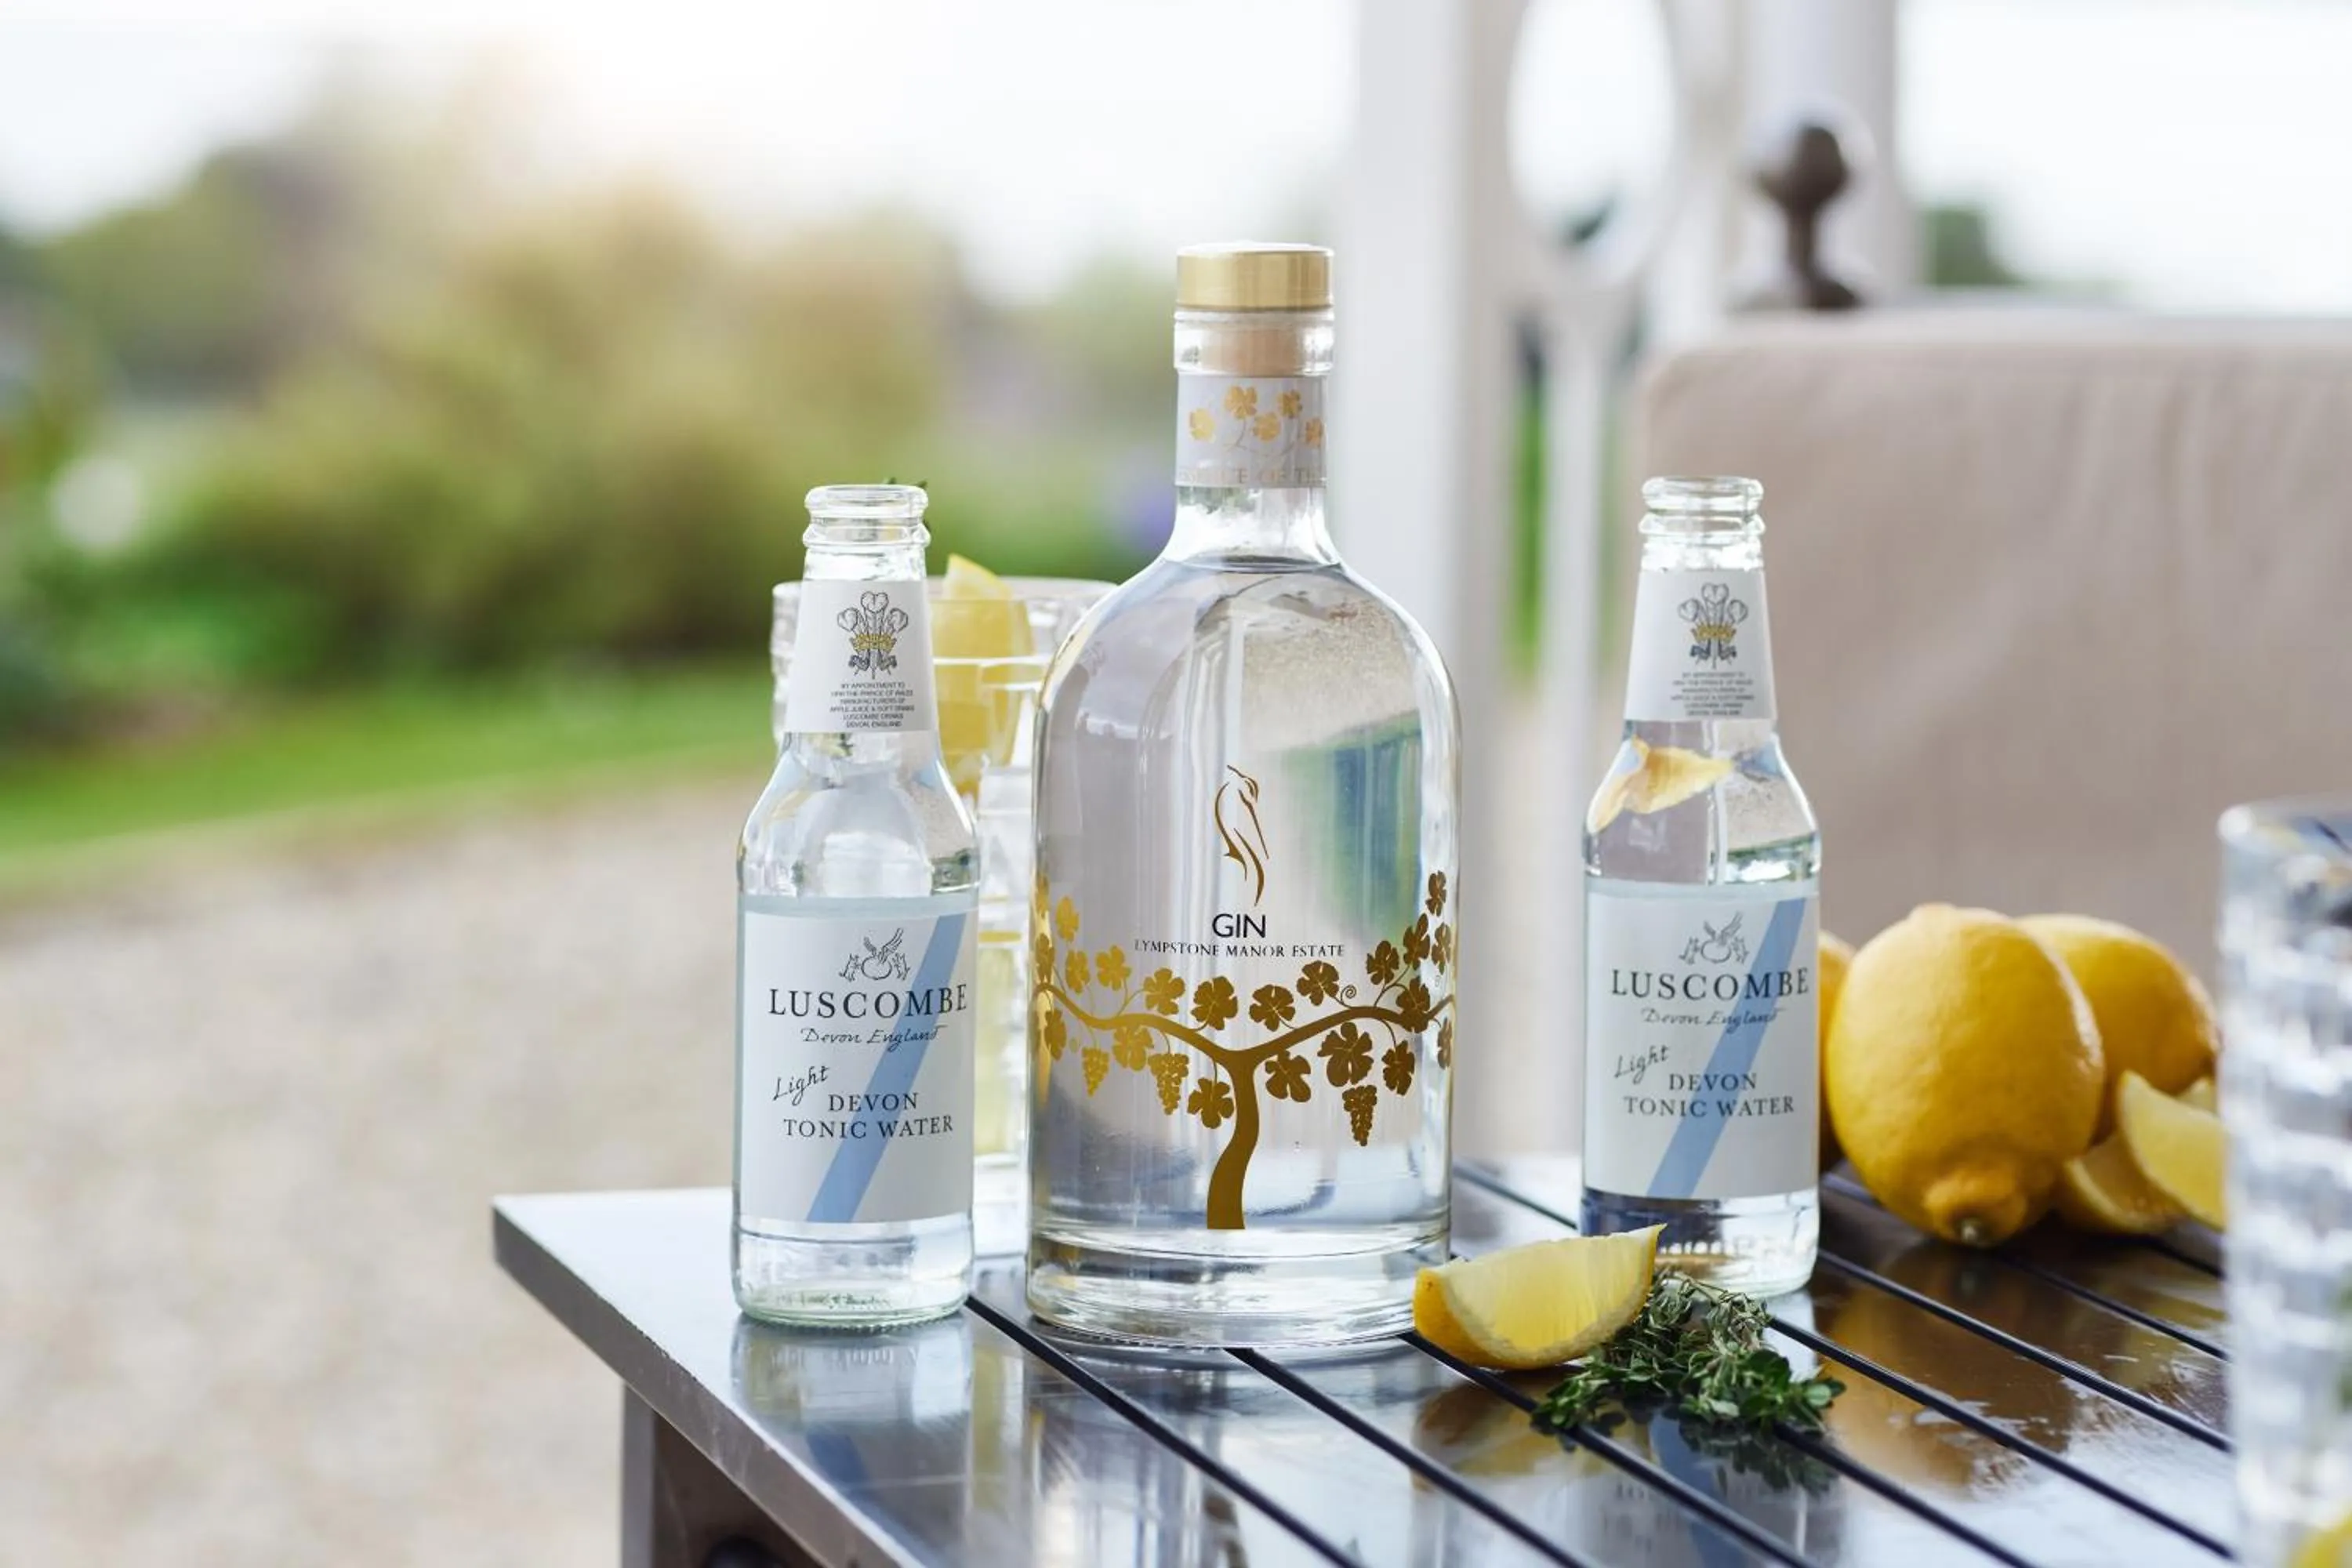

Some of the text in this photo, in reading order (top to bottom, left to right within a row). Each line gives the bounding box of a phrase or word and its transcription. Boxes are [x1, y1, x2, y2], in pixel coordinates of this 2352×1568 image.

[1211, 913, 1267, 938] GIN
[1134, 939, 1345, 958] LYMPSTONE MANOR ESTATE
[1611, 967, 1810, 1001] LUSCOMBE
[768, 983, 967, 1018] LUSCOMBE
[1641, 1007, 1788, 1035] Devon England
[800, 1024, 949, 1053] Devon England
[1613, 1044, 1671, 1086] Light
[772, 1065, 829, 1107] Light
[1668, 1073, 1758, 1092] DEVON
[828, 1092, 919, 1112] DEVON
[1623, 1095, 1795, 1118] TONIC WATER
[783, 1114, 954, 1139] TONIC WATER
